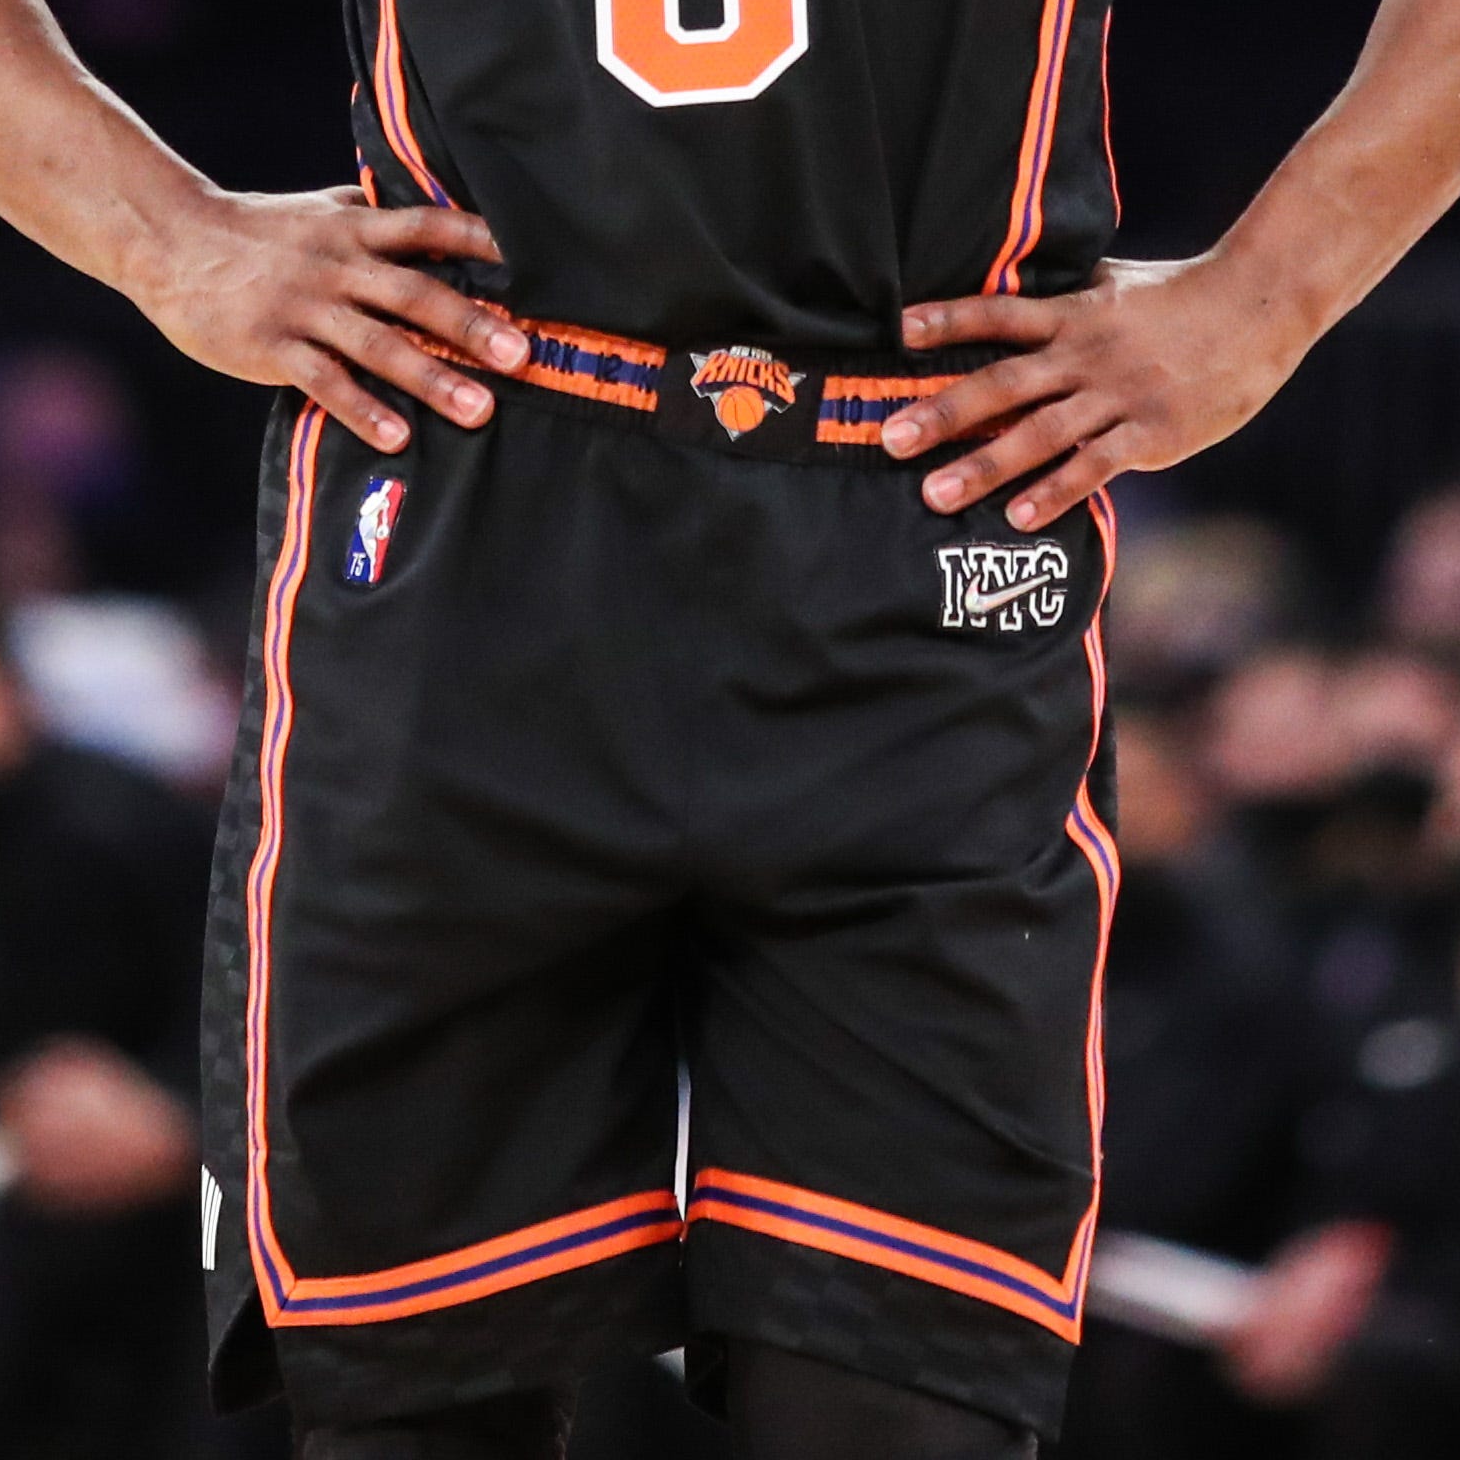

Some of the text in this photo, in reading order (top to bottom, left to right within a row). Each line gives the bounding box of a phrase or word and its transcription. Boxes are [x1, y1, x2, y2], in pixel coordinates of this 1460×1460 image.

[693, 351, 796, 404] KNICKS
[350, 552, 367, 577] 75
[938, 544, 1068, 631] NYC
